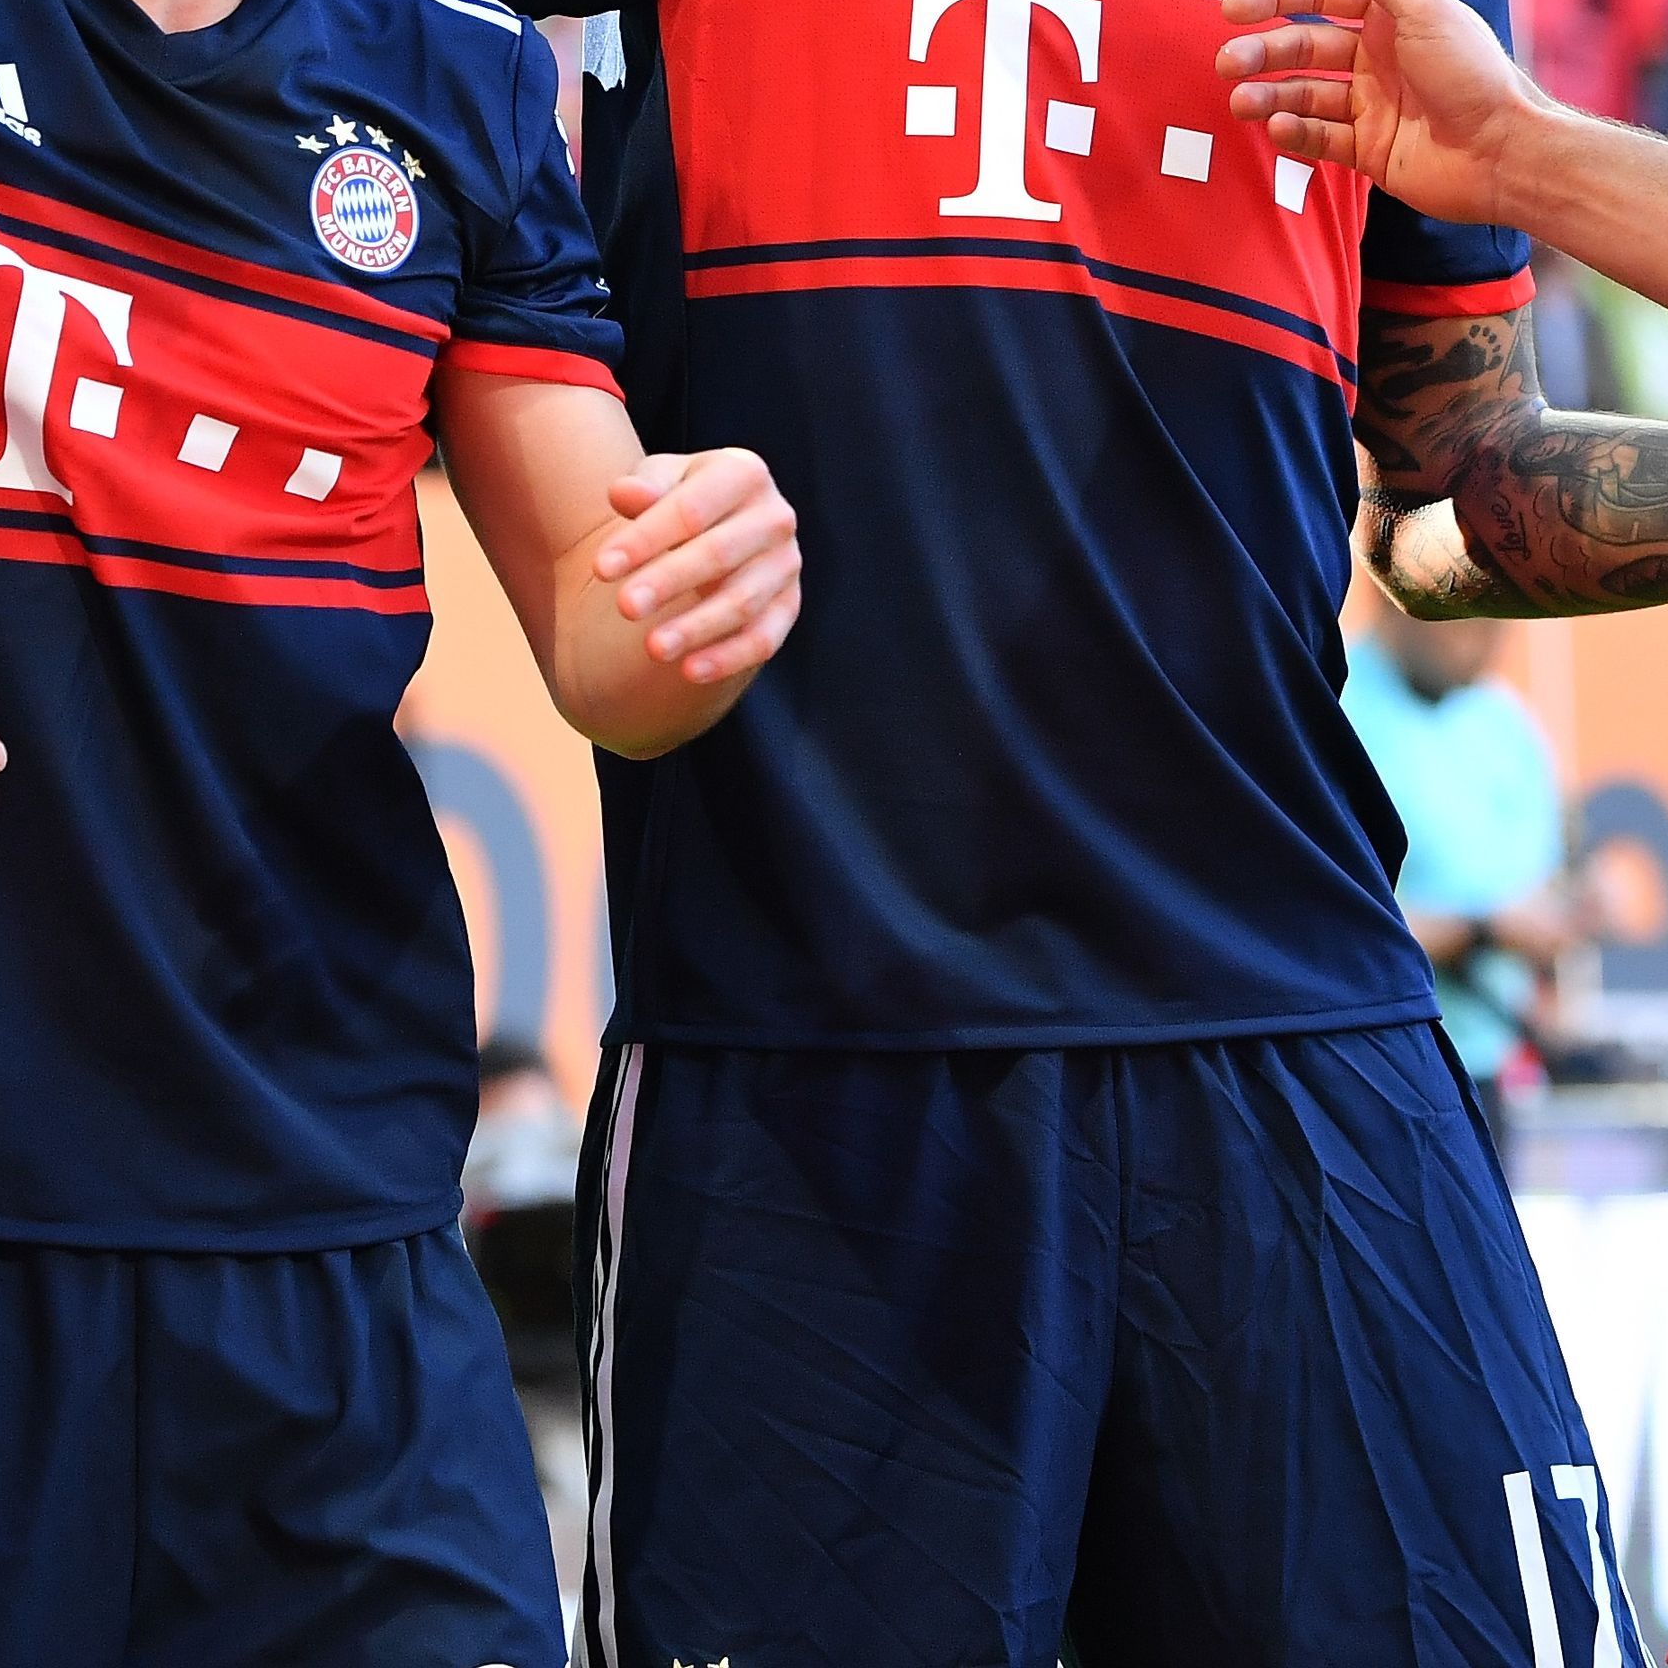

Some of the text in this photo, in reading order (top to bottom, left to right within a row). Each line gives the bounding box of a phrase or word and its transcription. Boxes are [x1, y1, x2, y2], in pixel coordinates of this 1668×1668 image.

[320, 155, 412, 213] FC BAYERN
[318, 212, 409, 266] MÜNCHEN
